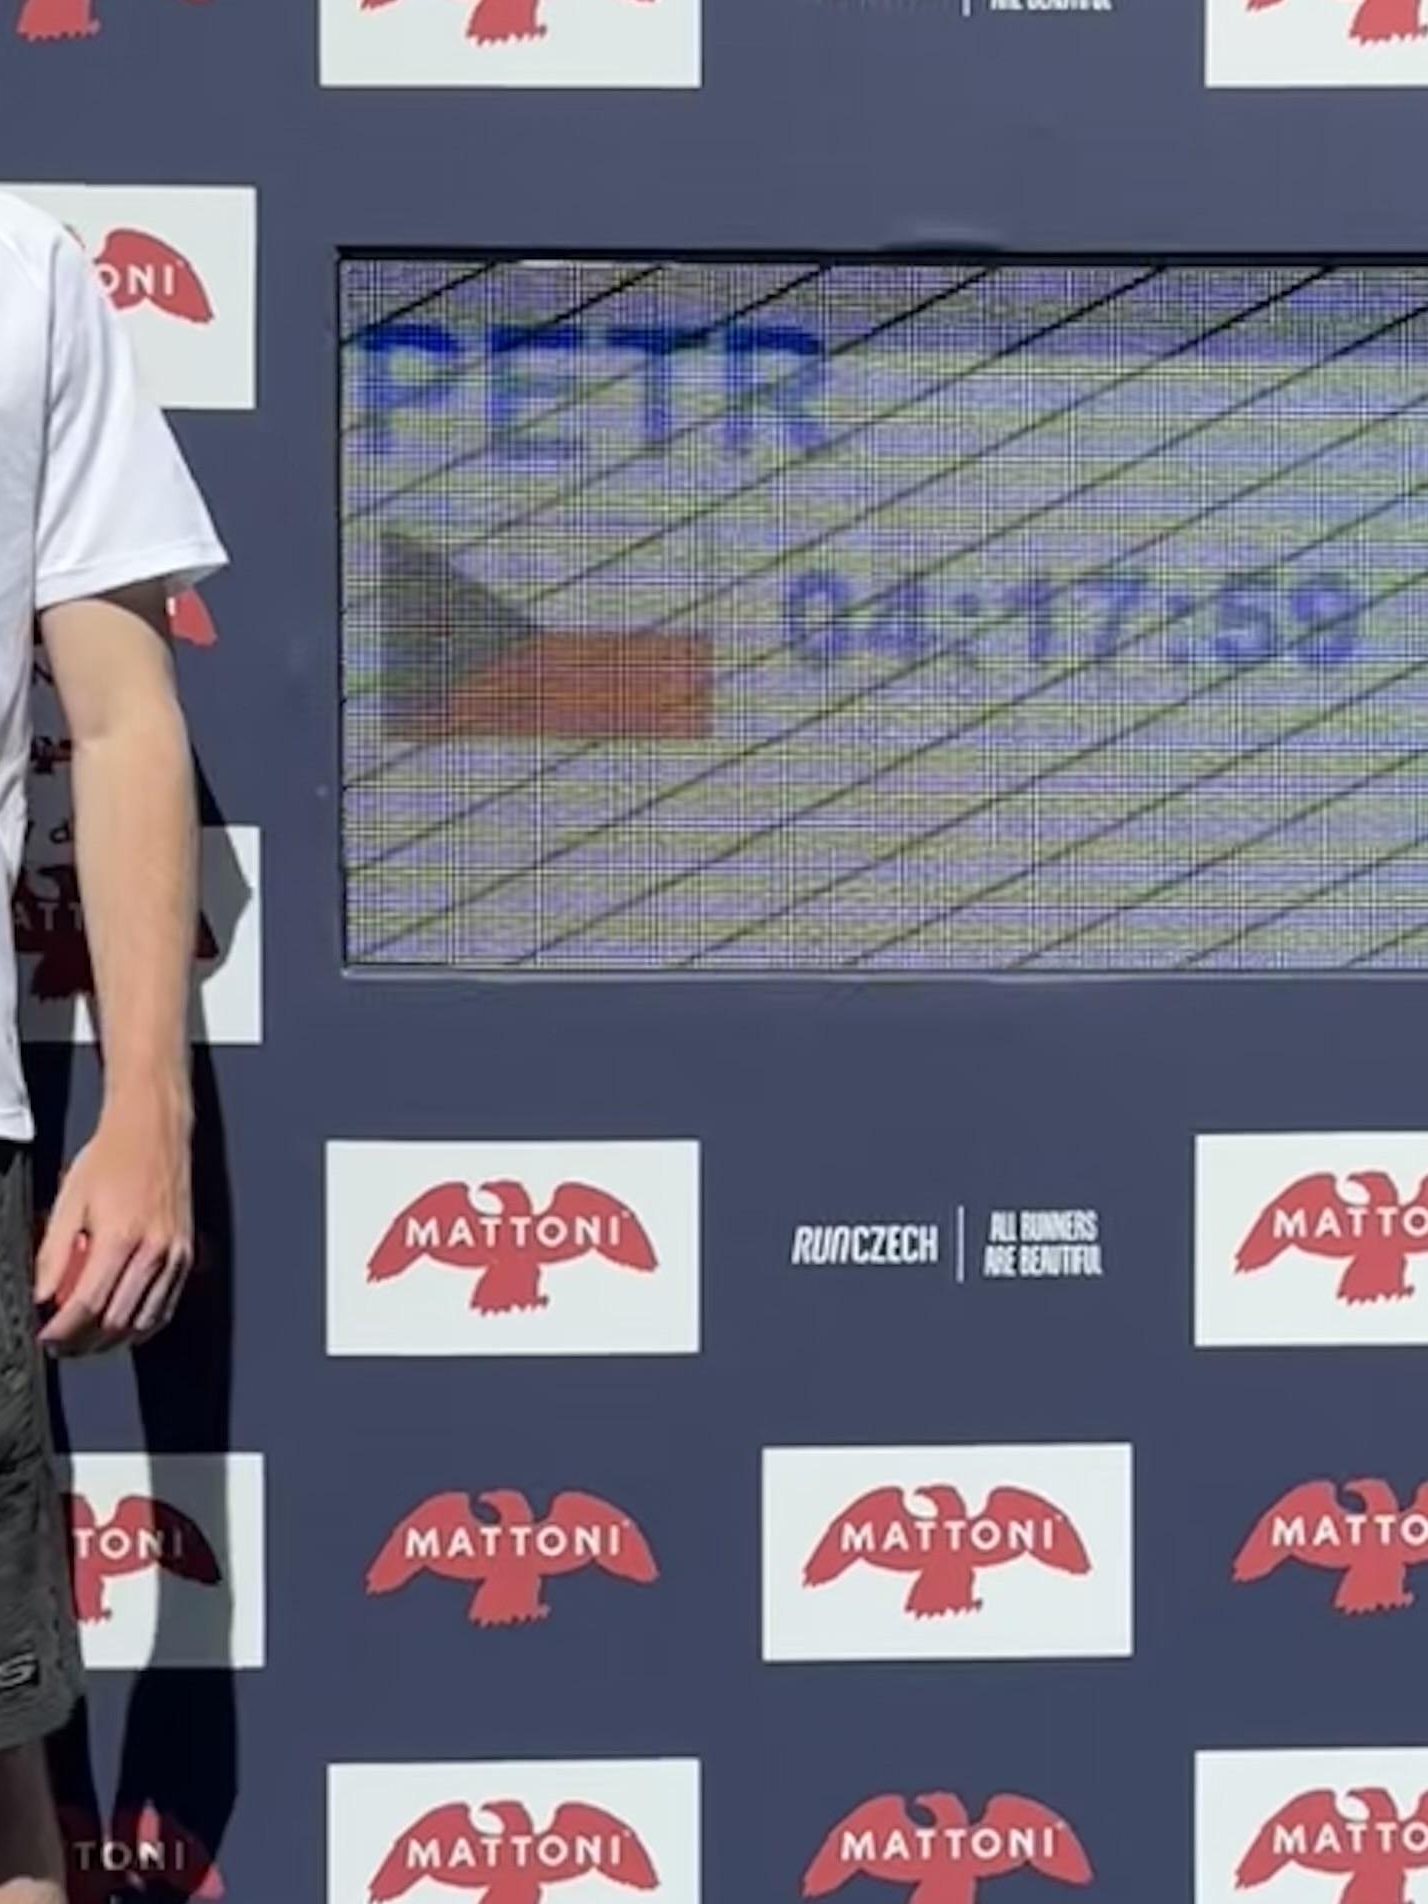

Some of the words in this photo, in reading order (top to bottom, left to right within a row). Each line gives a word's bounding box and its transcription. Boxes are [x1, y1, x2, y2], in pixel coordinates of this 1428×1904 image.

[354, 322, 832, 462] PETR
[779, 569, 1365, 669] 04:17:59
[406, 1216, 619, 1247] MATTONI
[989, 1210, 1017, 1242] ALL
[1020, 1209, 1099, 1242] RUNNERS
[791, 1225, 939, 1265] RUNCZECH
[983, 1244, 1016, 1276] ARE
[1020, 1244, 1104, 1276] BEAUTIFUL
[72, 1527, 182, 1560] TONI
[405, 1525, 619, 1557] MATTONI
[841, 1519, 1053, 1551] MATTONI
[74, 1841, 185, 1871] TONI
[407, 1835, 620, 1868] MATTONI
[841, 1827, 1053, 1861] MATTONI
